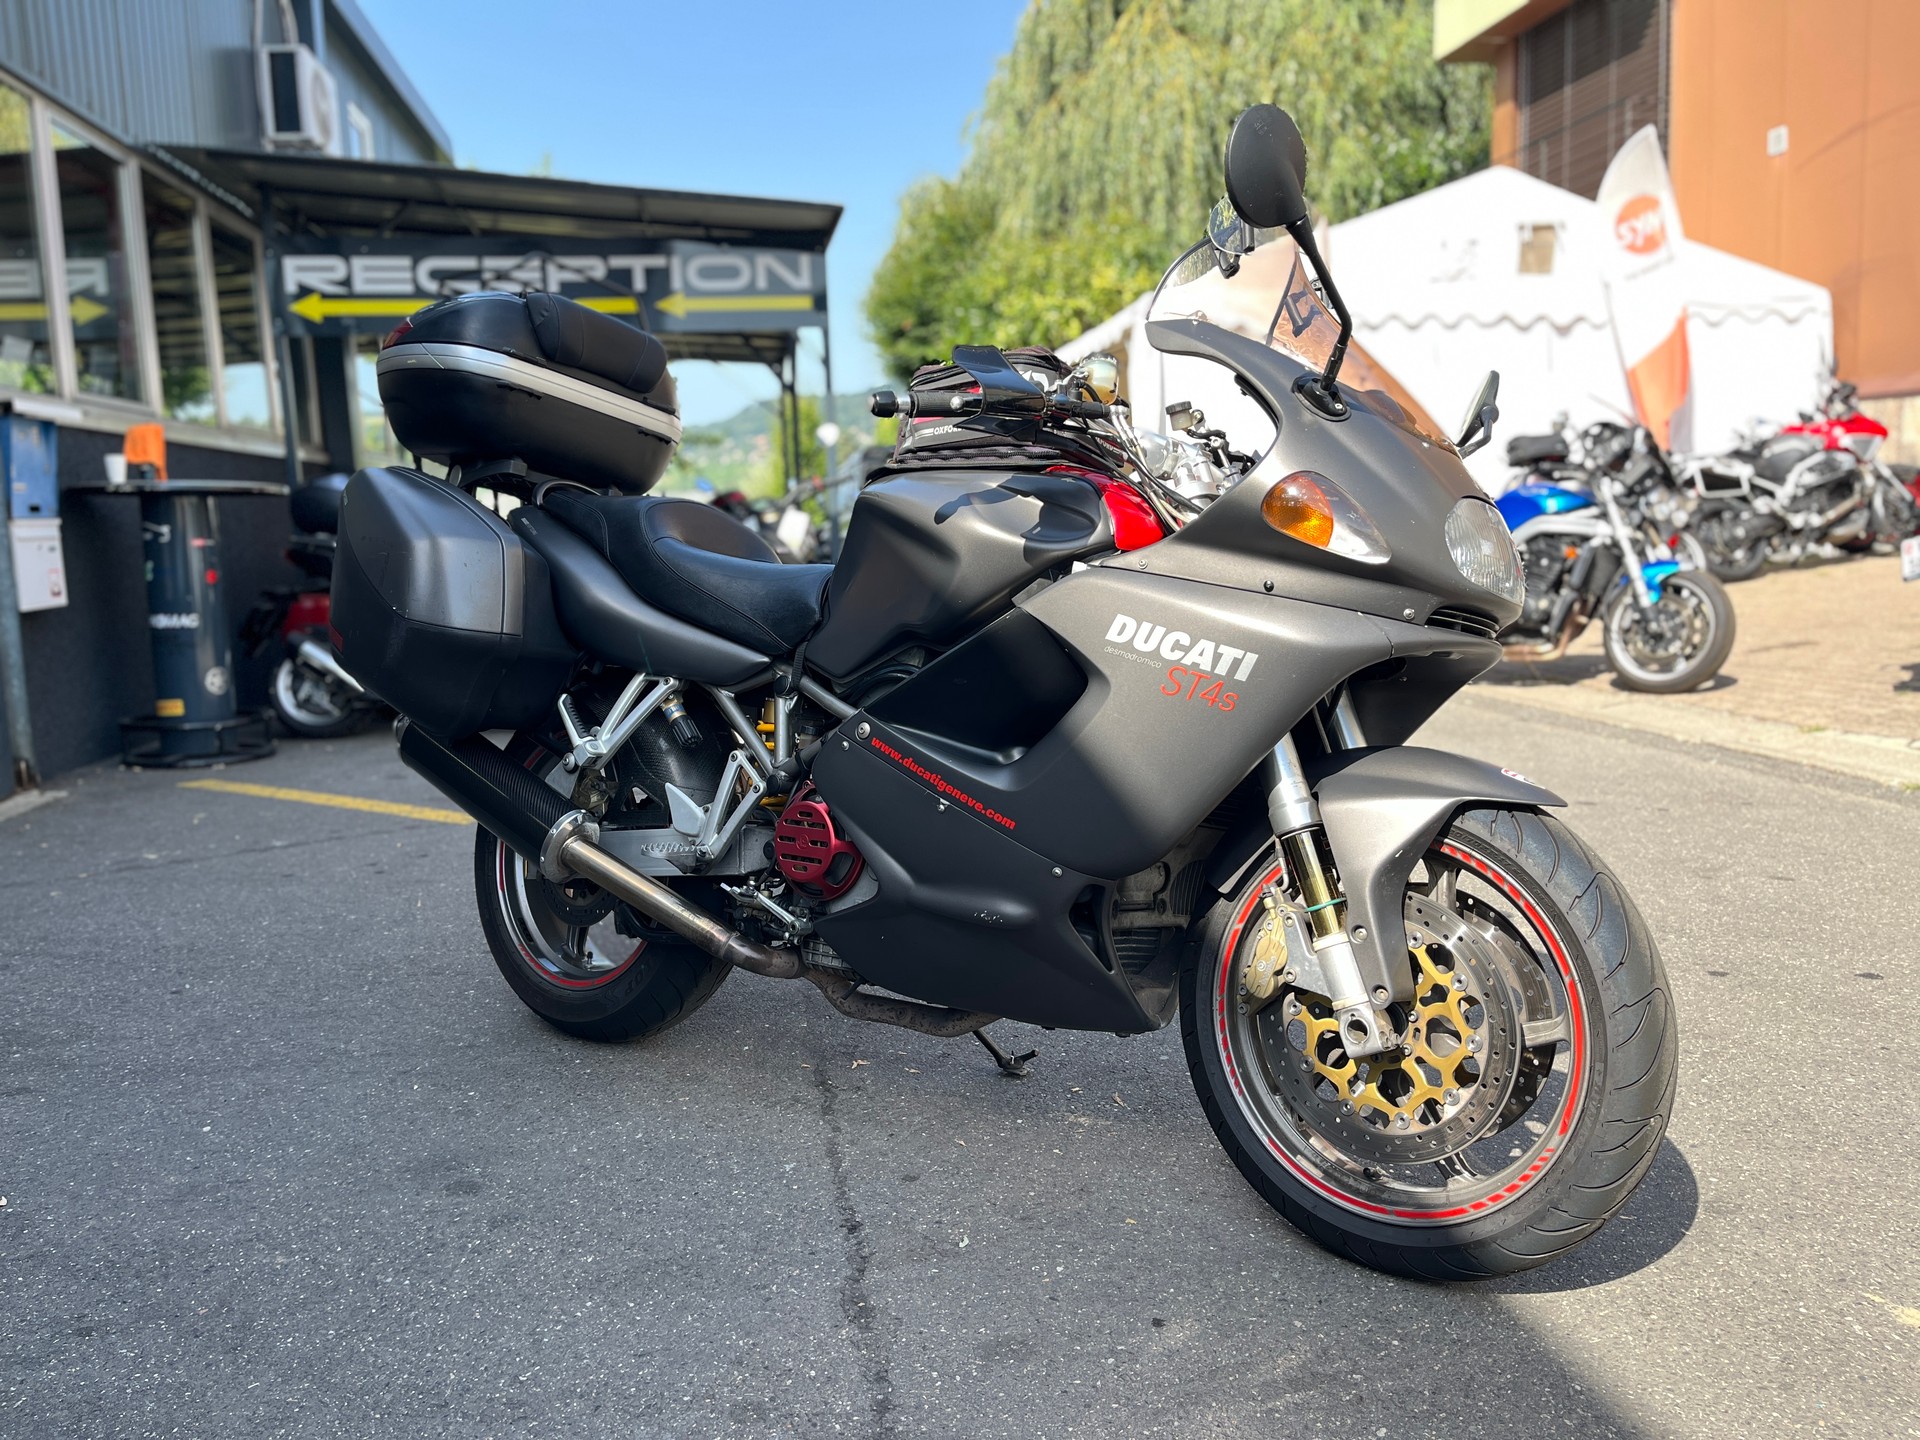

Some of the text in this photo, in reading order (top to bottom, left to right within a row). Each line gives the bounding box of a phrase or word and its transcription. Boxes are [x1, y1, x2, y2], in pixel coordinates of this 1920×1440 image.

[281, 253, 813, 296] RECEPTION
[933, 424, 966, 435] OXFO
[1104, 645, 1162, 669] desmodromico
[1105, 613, 1259, 682] DUCATI
[871, 737, 1016, 830] www.ducatigeneve.com
